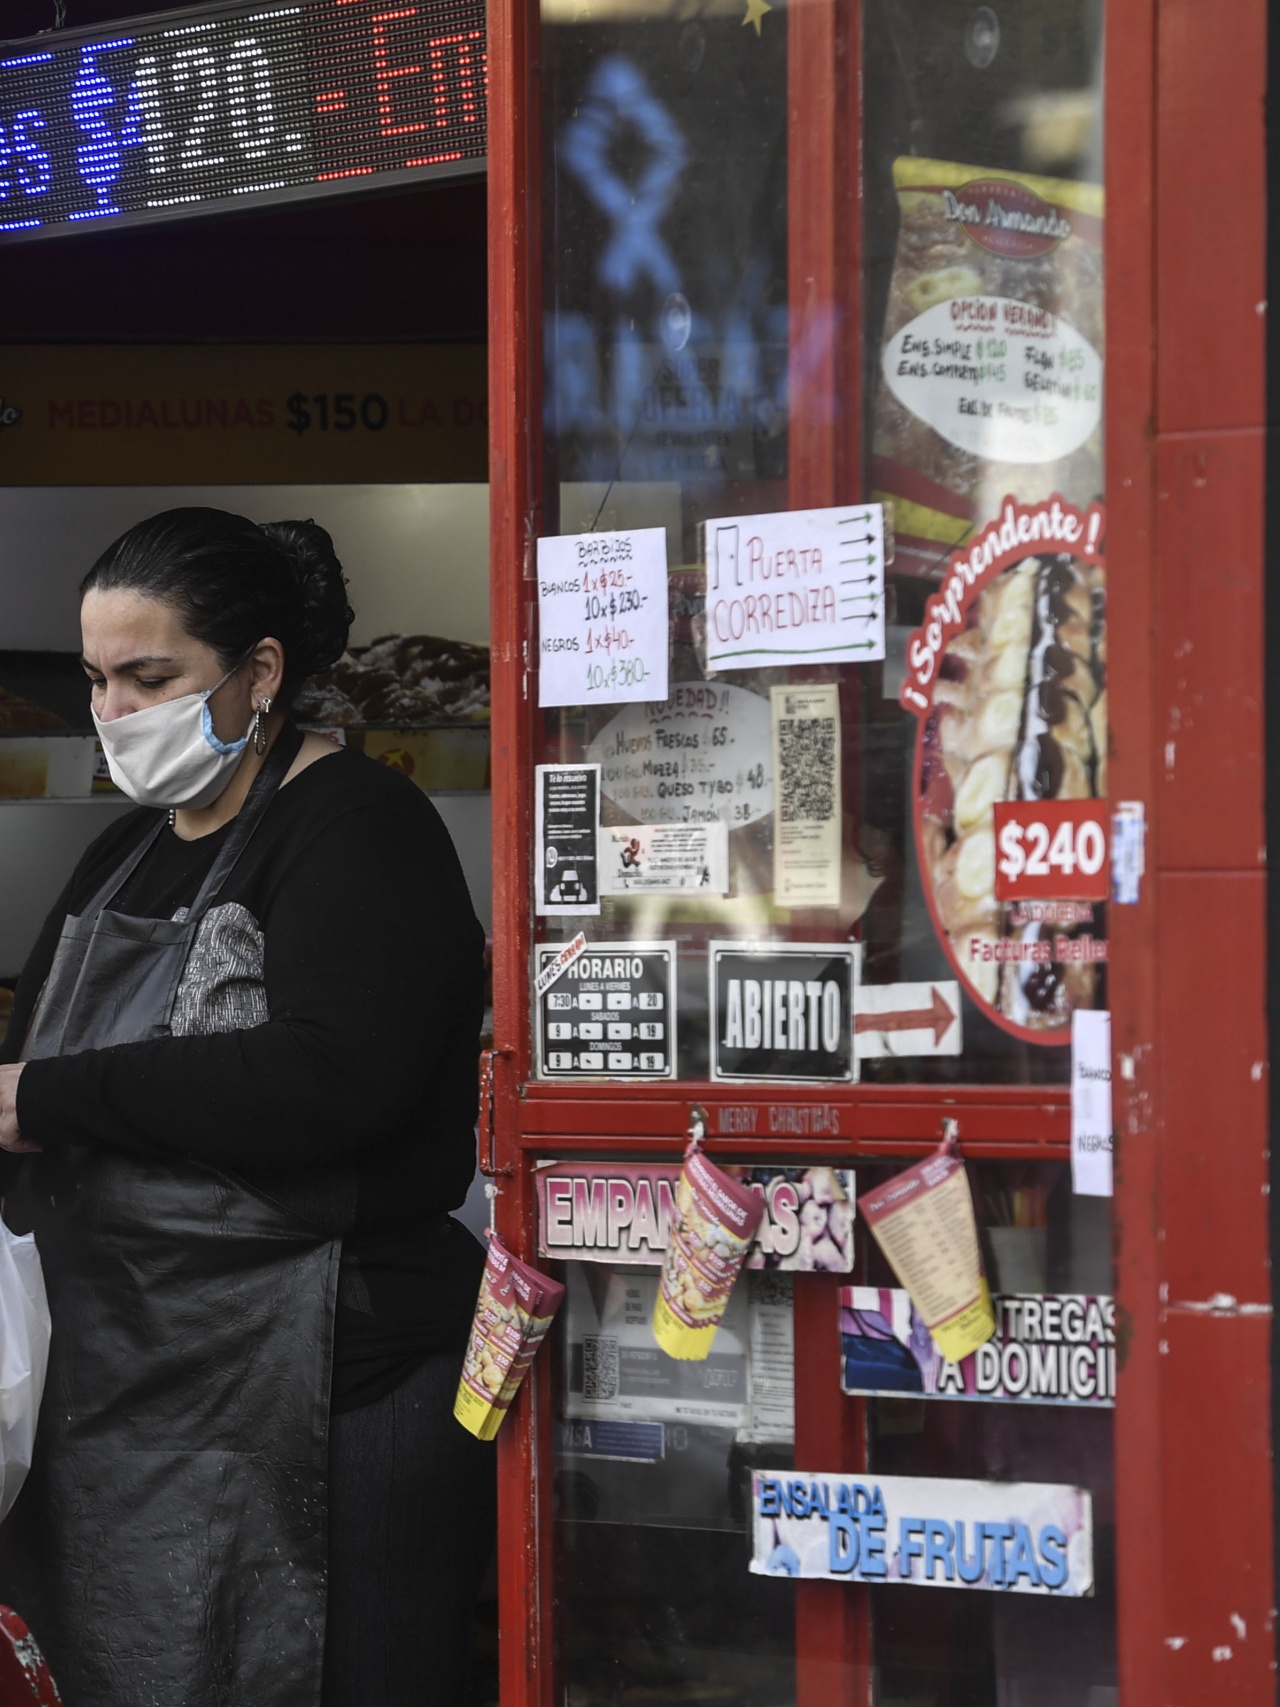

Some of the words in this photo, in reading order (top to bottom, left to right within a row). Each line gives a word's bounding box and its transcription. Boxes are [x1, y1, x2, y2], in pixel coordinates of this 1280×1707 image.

[49, 401, 276, 430] MEDIALUNAS
[286, 391, 389, 437] $150
[398, 401, 442, 428] LA
[746, 536, 823, 582] PUERTA
[542, 637, 580, 652] NEGROS
[657, 781, 695, 799] QUESO
[998, 819, 1106, 883] $240
[970, 936, 1052, 964] Facturas
[567, 958, 644, 979] HORARIO
[572, 997, 579, 1008] A
[646, 993, 657, 1007] 20
[579, 982, 599, 991] LUNES
[606, 982, 631, 991] VIERNES
[591, 1012, 620, 1021] SABADOS
[725, 978, 842, 1054] ABIERTO
[573, 1026, 579, 1038] A
[589, 1042, 623, 1051] DOMINGOS
[573, 1056, 579, 1067] A
[718, 1105, 757, 1134] MERRY
[769, 1104, 840, 1135] CHRISTMAS
[545, 1175, 802, 1257] EMPANAS
[991, 1300, 1116, 1344] TREGAS
[759, 1478, 887, 1523] ENSALADA
[827, 1512, 889, 1577] DE
[899, 1517, 1069, 1590] FRUTAS
